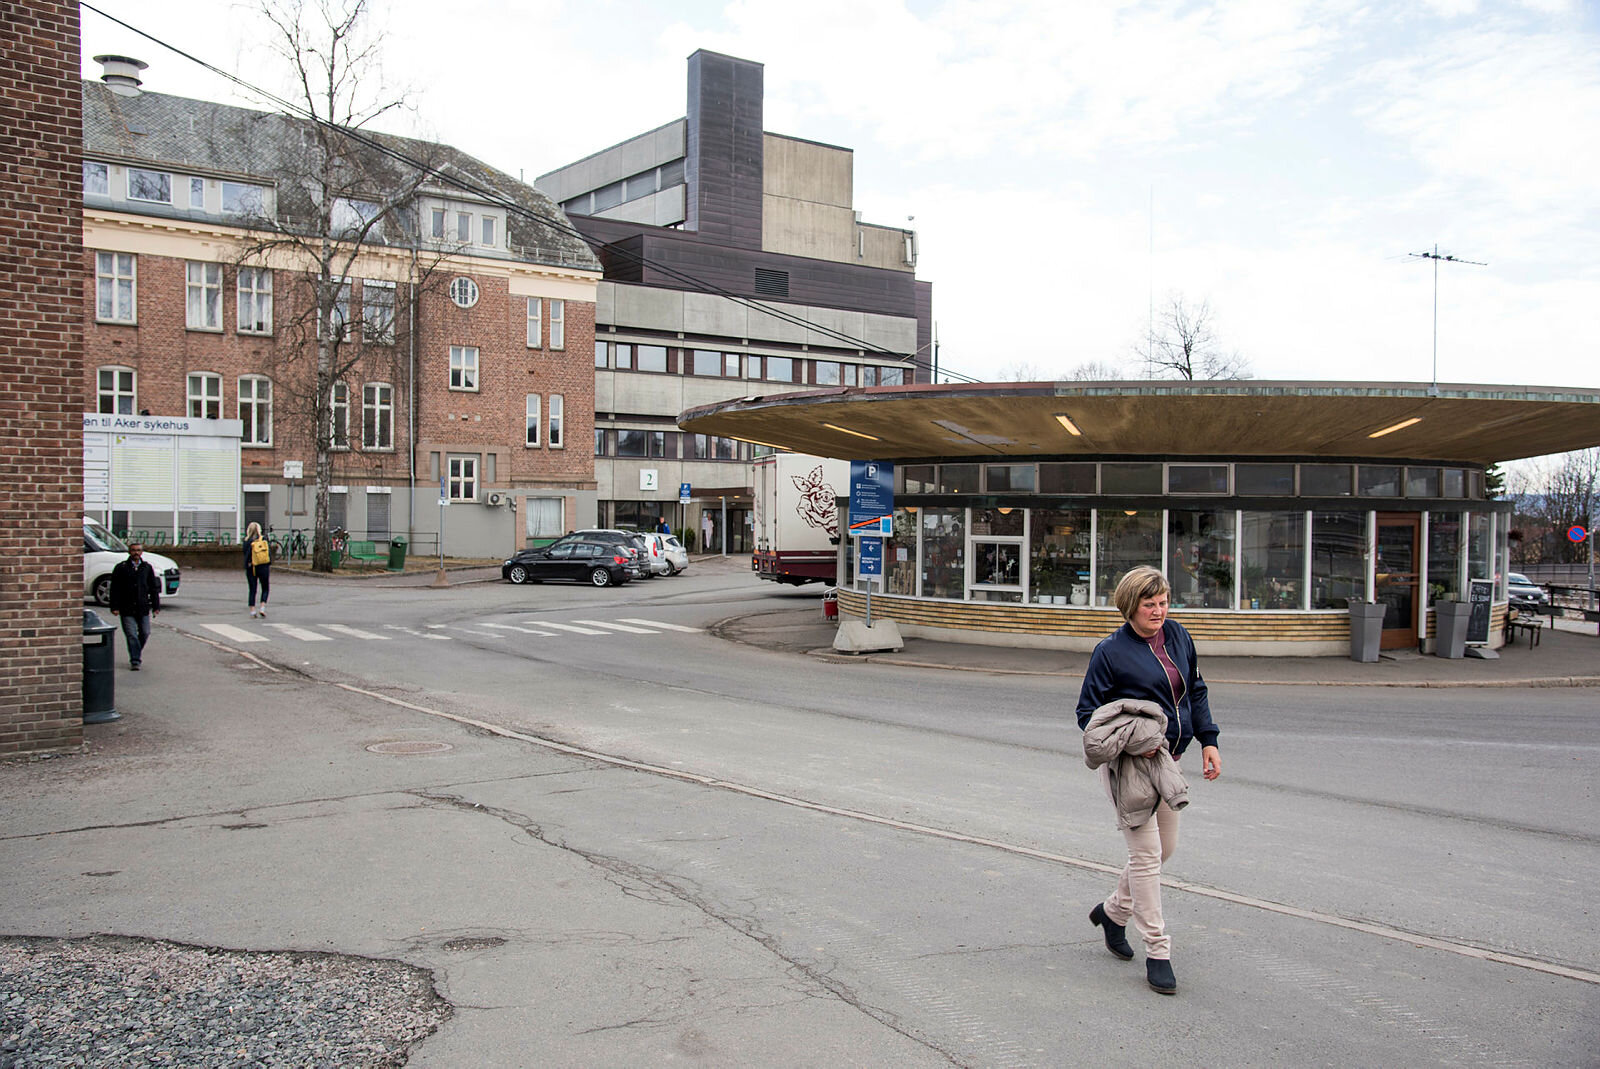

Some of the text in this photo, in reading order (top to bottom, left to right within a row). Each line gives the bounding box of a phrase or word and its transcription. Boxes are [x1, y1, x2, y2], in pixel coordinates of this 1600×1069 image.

[101, 418, 111, 427] til
[114, 418, 142, 428] Aker
[143, 419, 190, 431] sykehus
[868, 465, 877, 477] P
[646, 473, 653, 486] 2
